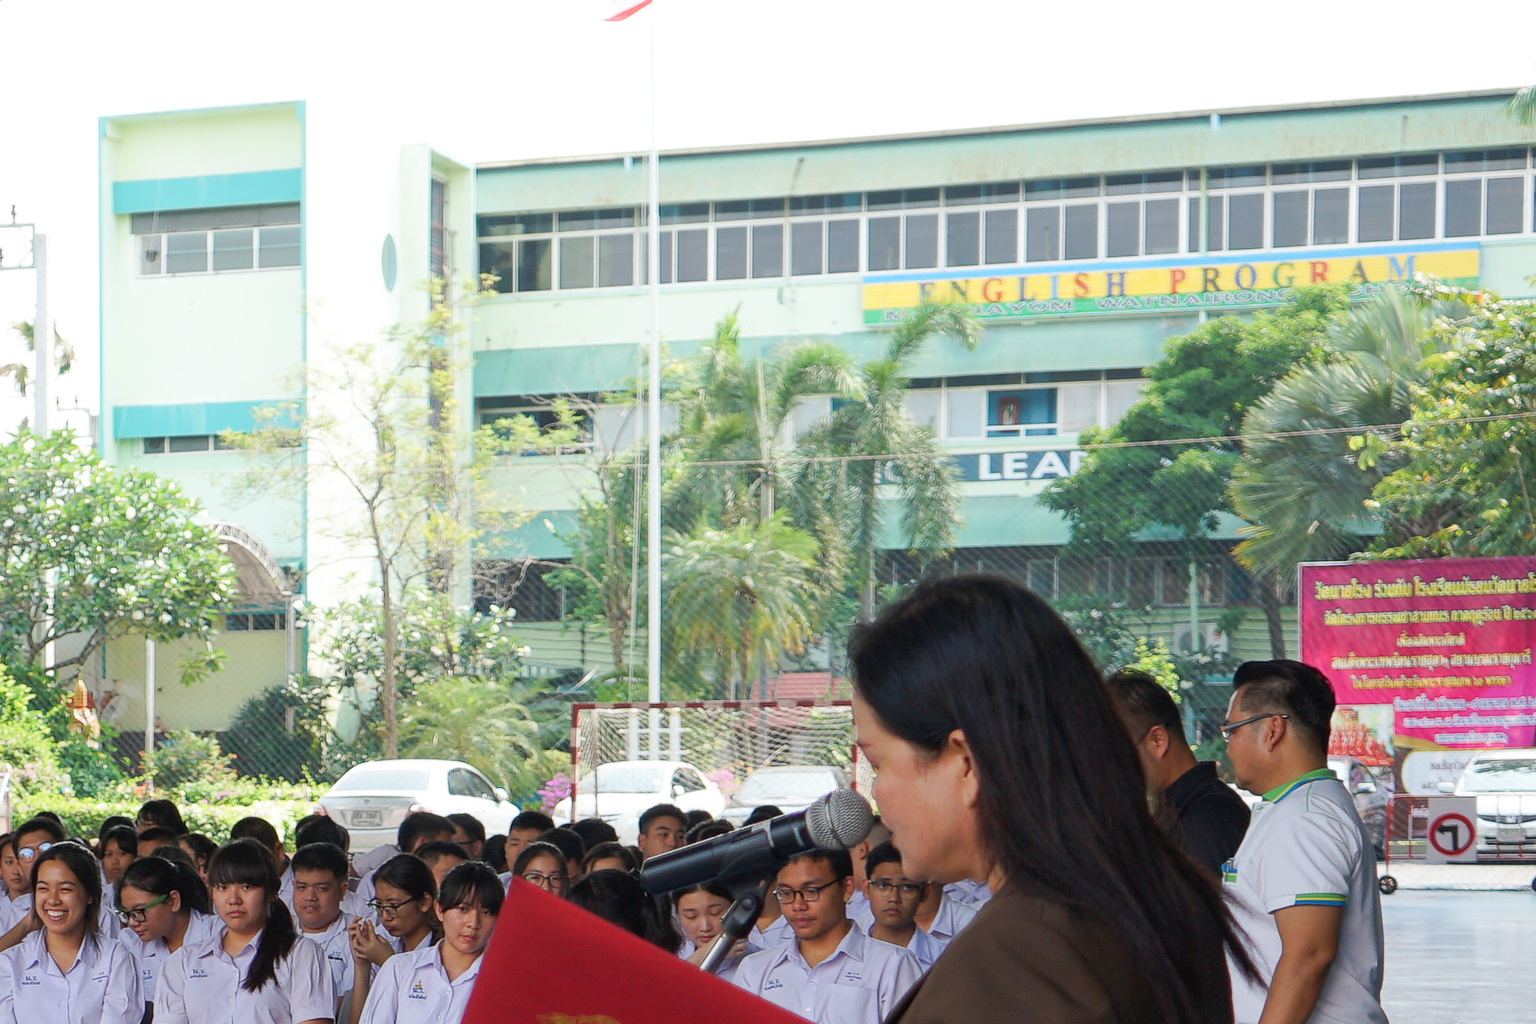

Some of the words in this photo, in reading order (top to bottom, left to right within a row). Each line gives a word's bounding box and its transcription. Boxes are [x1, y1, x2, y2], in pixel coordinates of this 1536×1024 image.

[919, 271, 1127, 304] ENGLISH
[1170, 254, 1416, 295] PROGRAM
[1315, 577, 1373, 600] วัดนายโรง
[1374, 577, 1413, 599] ร่วมกับ
